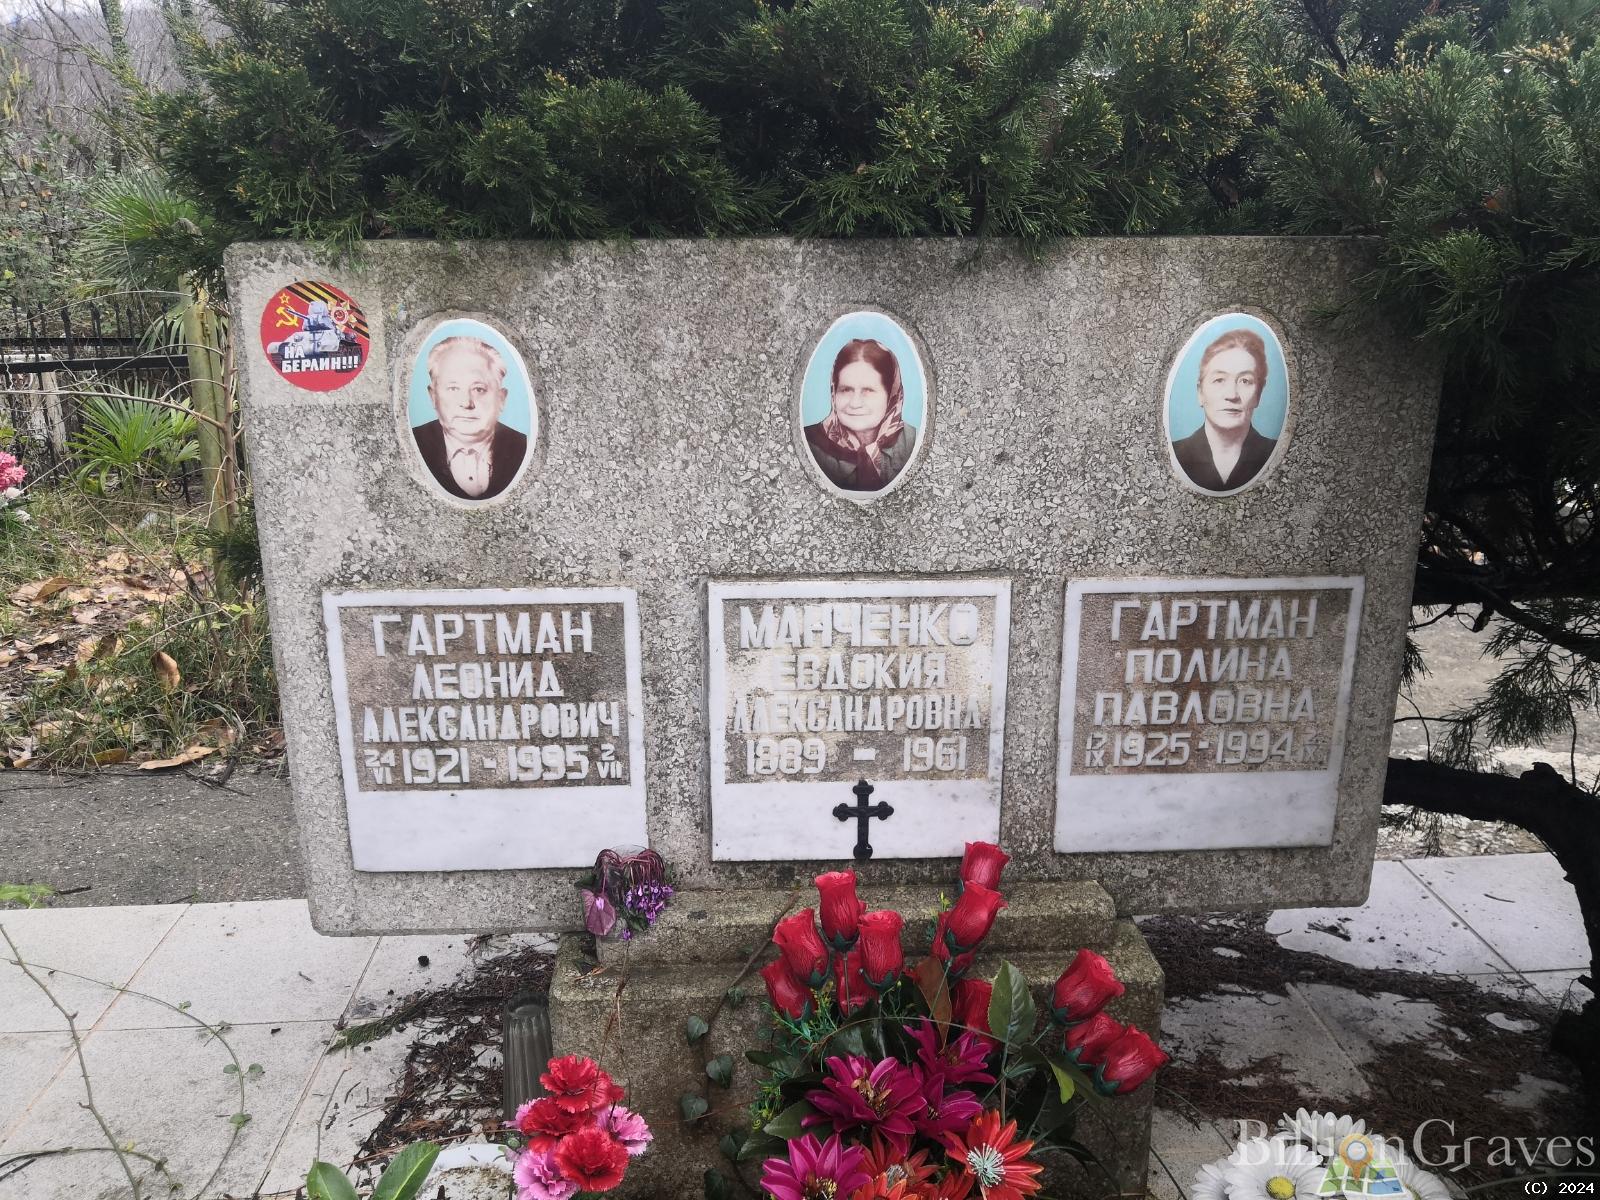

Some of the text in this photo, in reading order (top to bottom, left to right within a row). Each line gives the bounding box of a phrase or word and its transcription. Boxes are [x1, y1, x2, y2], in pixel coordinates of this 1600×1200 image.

[281, 356, 359, 373] БЕРЛИН!!!
[284, 345, 305, 359] НА
[372, 611, 593, 656] ГАРТМАН
[740, 602, 978, 648] МАНЧЕНКО
[1111, 599, 1318, 641] ГАРТМАН
[412, 660, 564, 700] ЛЕОНИД
[773, 652, 946, 691] ЕВДОКИЯ
[1125, 647, 1292, 683] ПОЛИНА
[363, 702, 620, 743] АЛЕКСАНДРОВИЧ
[733, 694, 982, 733] АЛЕКСАНДРОВНА
[1094, 687, 1317, 726] ПАВЛОВНА
[364, 749, 395, 767] 24
[402, 747, 470, 784] 1921
[508, 744, 589, 782] 1995
[600, 743, 615, 761] 2
[747, 737, 826, 775] 1889
[904, 736, 967, 772] 1961
[373, 767, 392, 784] VI
